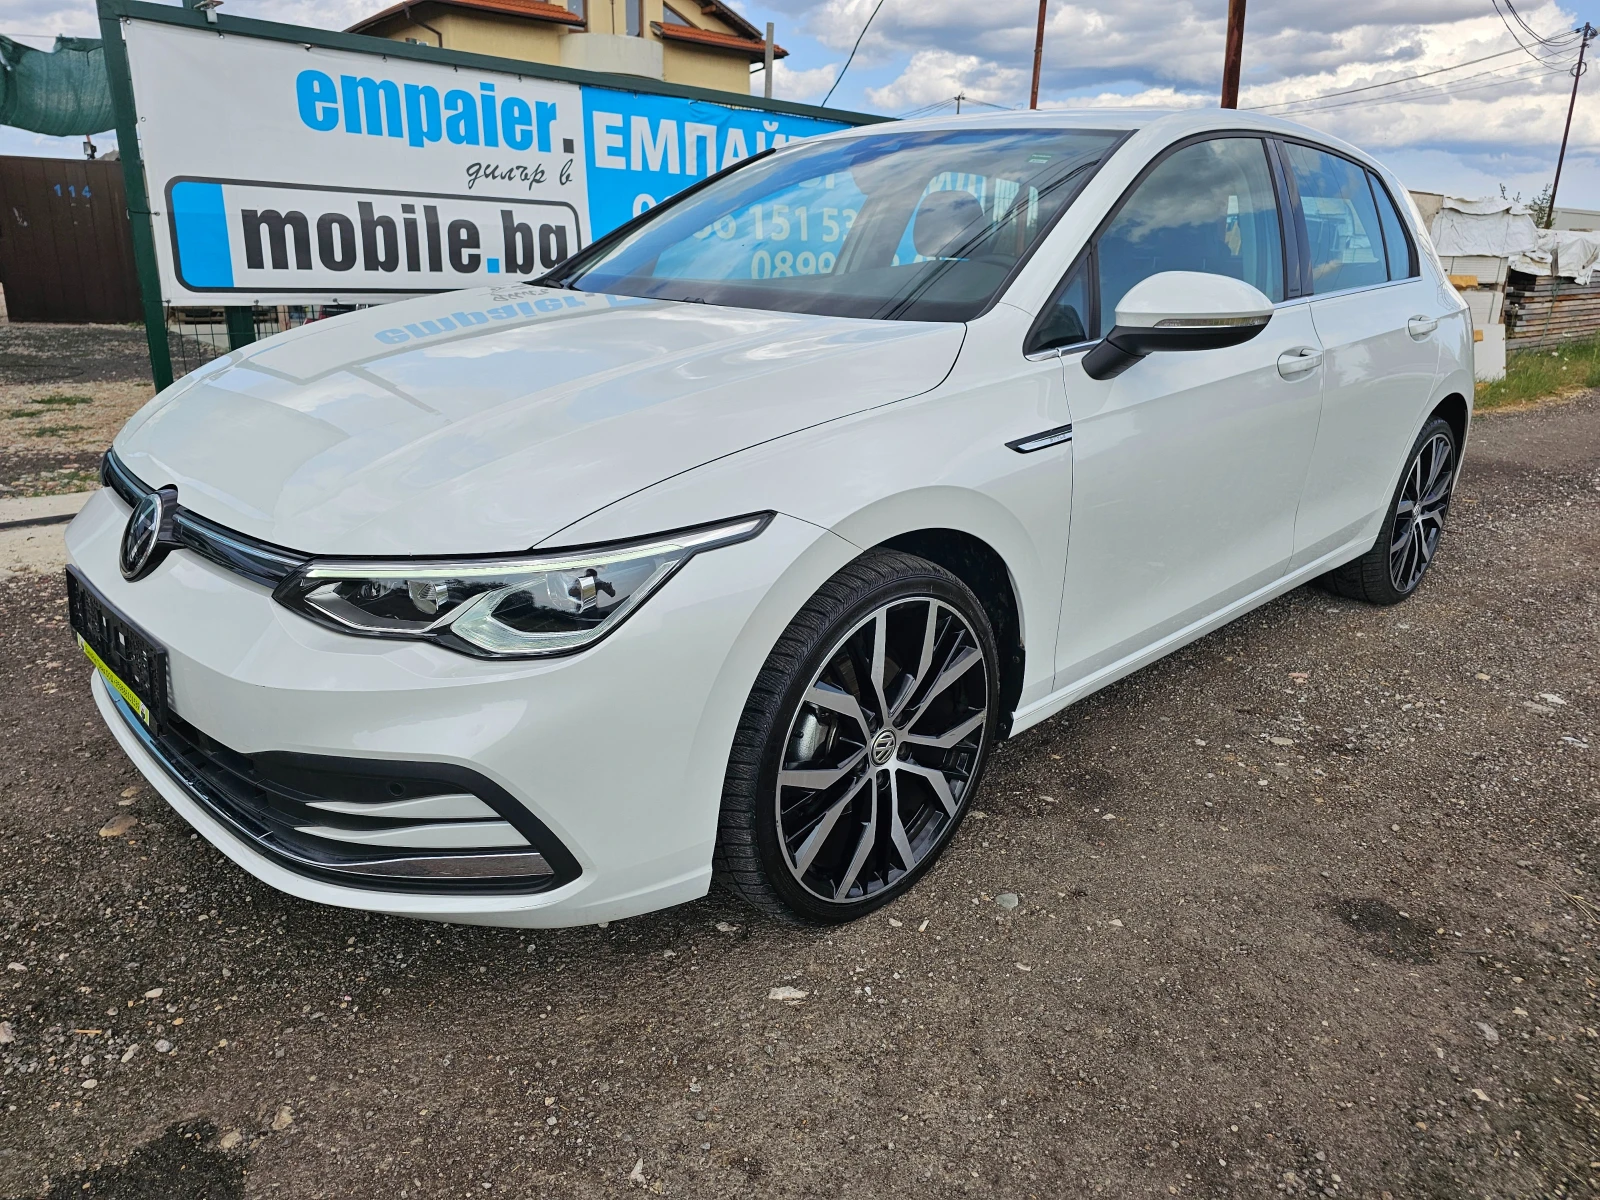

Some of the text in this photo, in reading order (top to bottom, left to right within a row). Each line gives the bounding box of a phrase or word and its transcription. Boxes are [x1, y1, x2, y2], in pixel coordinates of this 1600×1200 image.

[295, 69, 575, 154] empaier.
[53, 183, 92, 199] 114
[465, 158, 574, 192] дилър в
[241, 201, 569, 275] mobile.bg
[749, 203, 809, 242] 151
